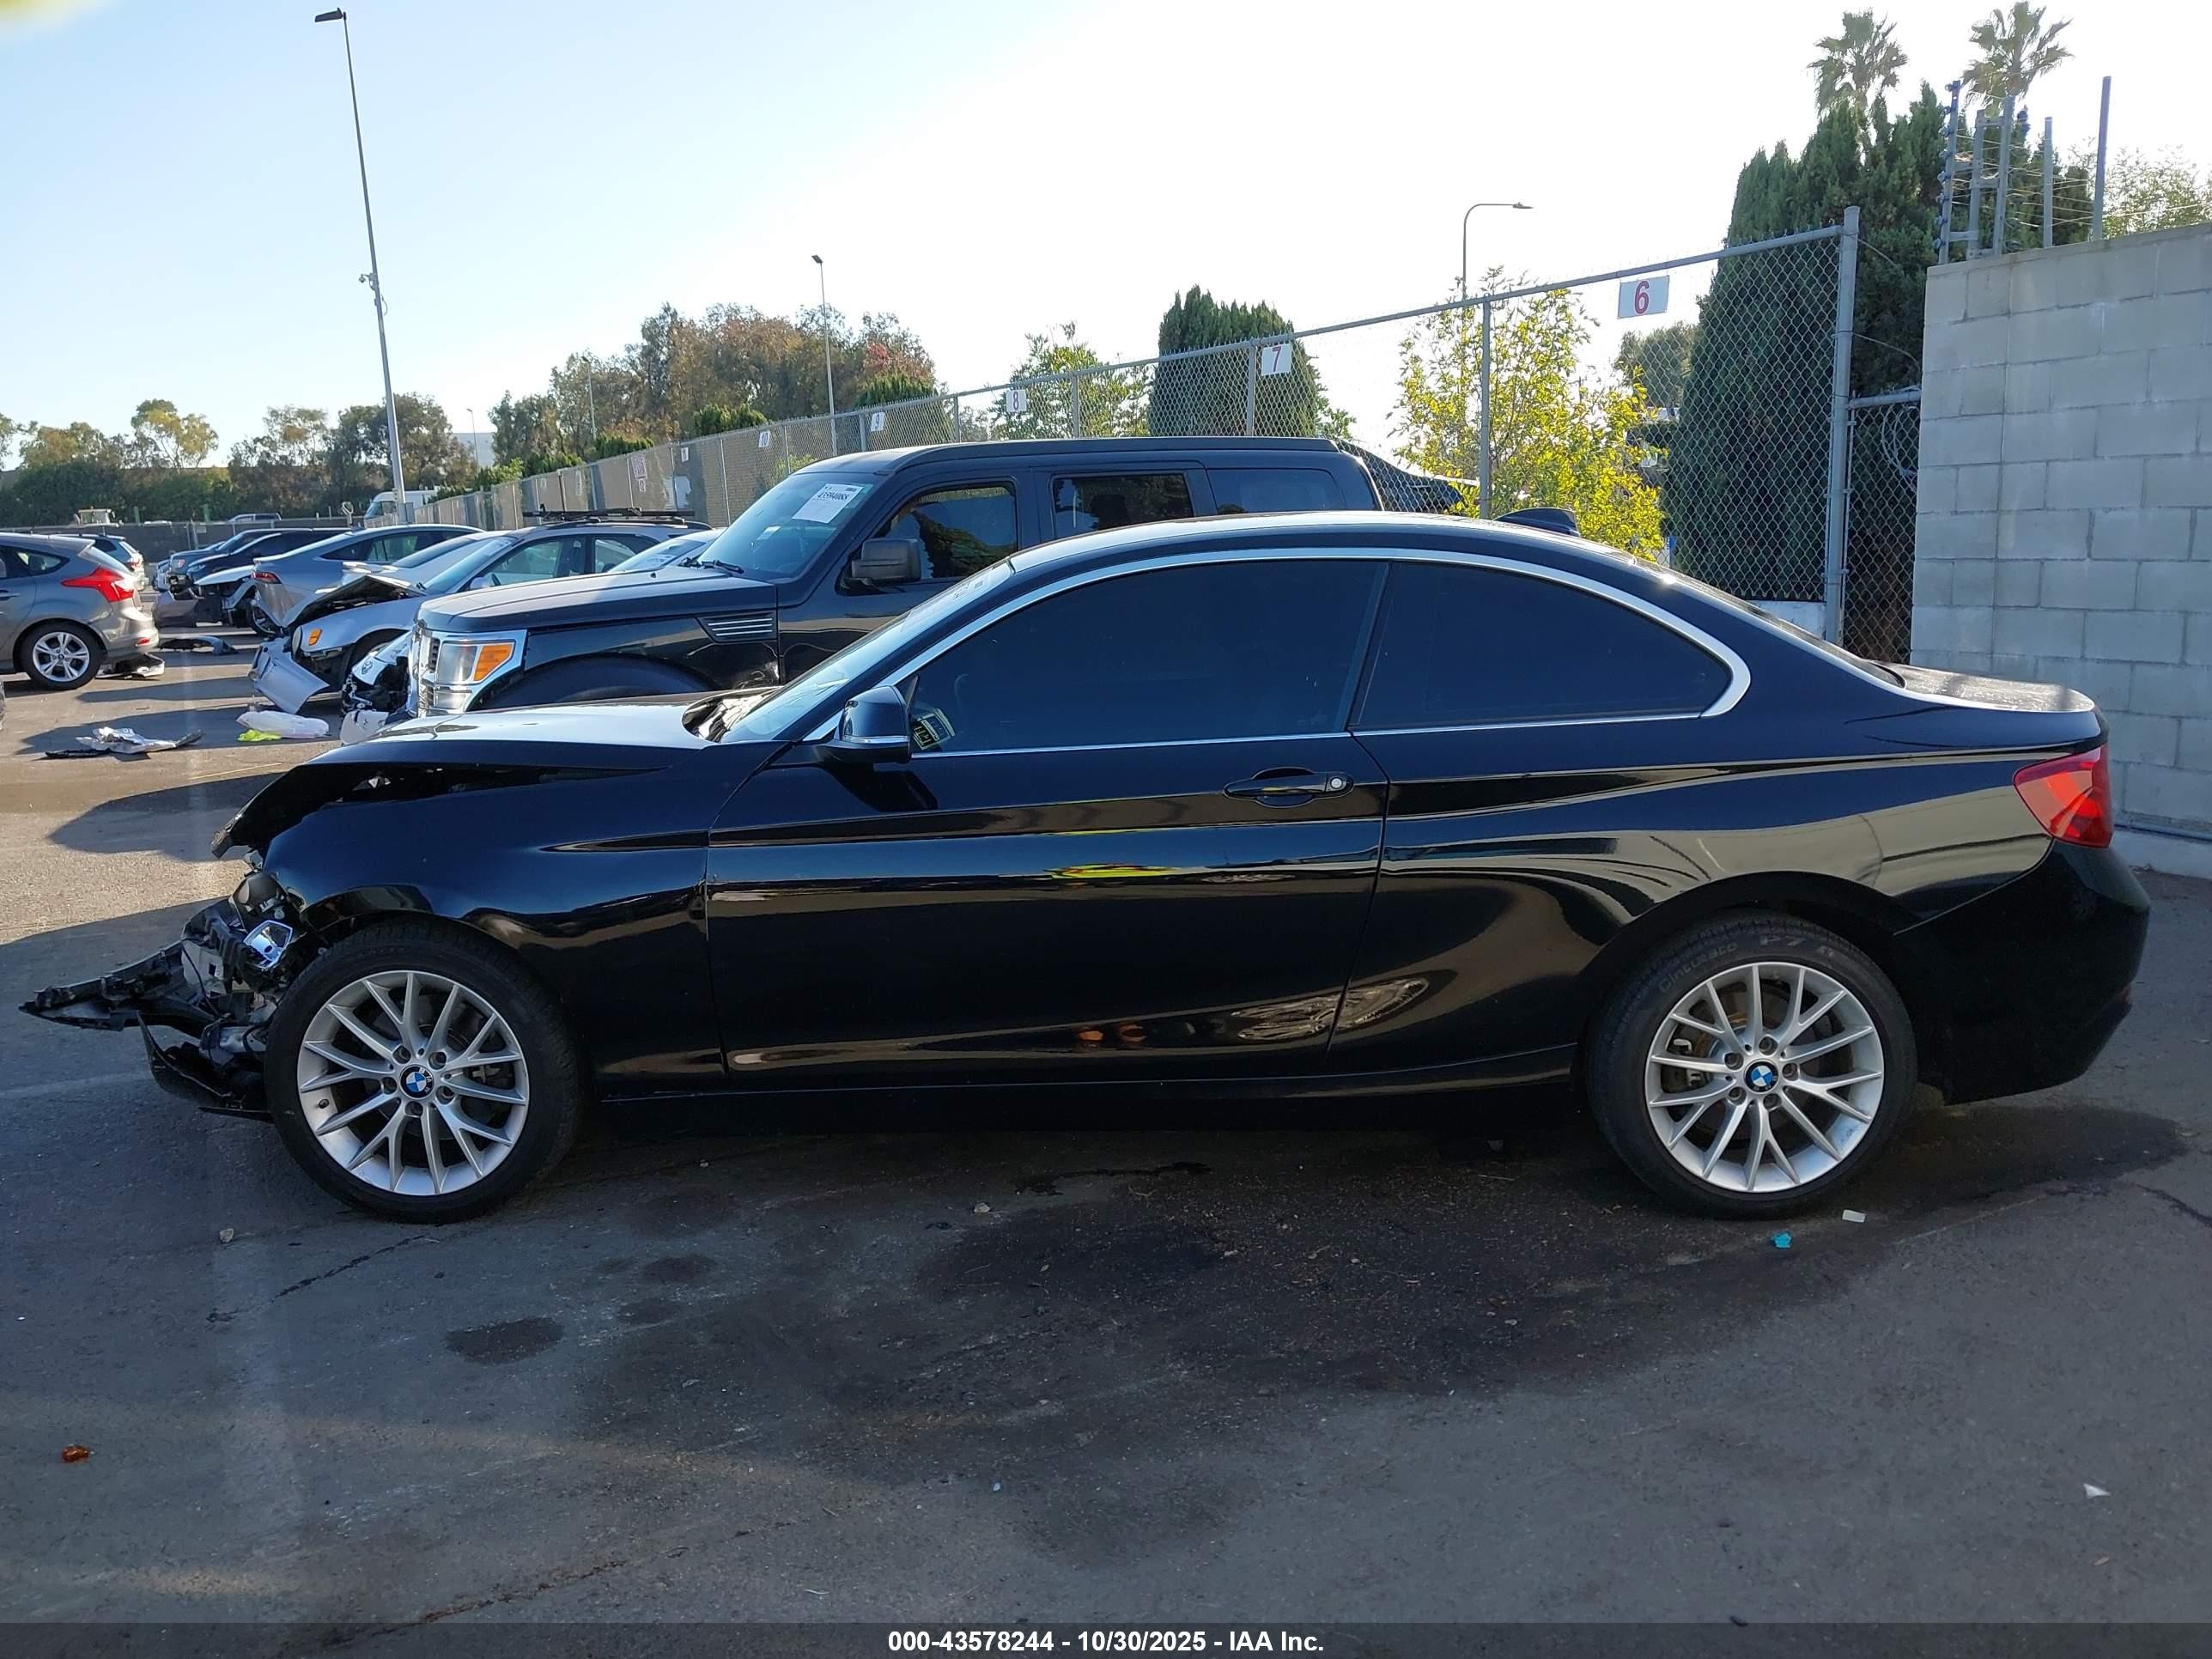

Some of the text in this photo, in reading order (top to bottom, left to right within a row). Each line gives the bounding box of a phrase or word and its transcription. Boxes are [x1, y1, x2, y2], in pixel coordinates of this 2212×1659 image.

[1634, 281, 1650, 314] 6
[1272, 346, 1282, 372] 7
[1012, 391, 1019, 410] 8
[874, 412, 880, 429] 9
[761, 432, 769, 446] 10
[1759, 933, 1806, 946] P7
